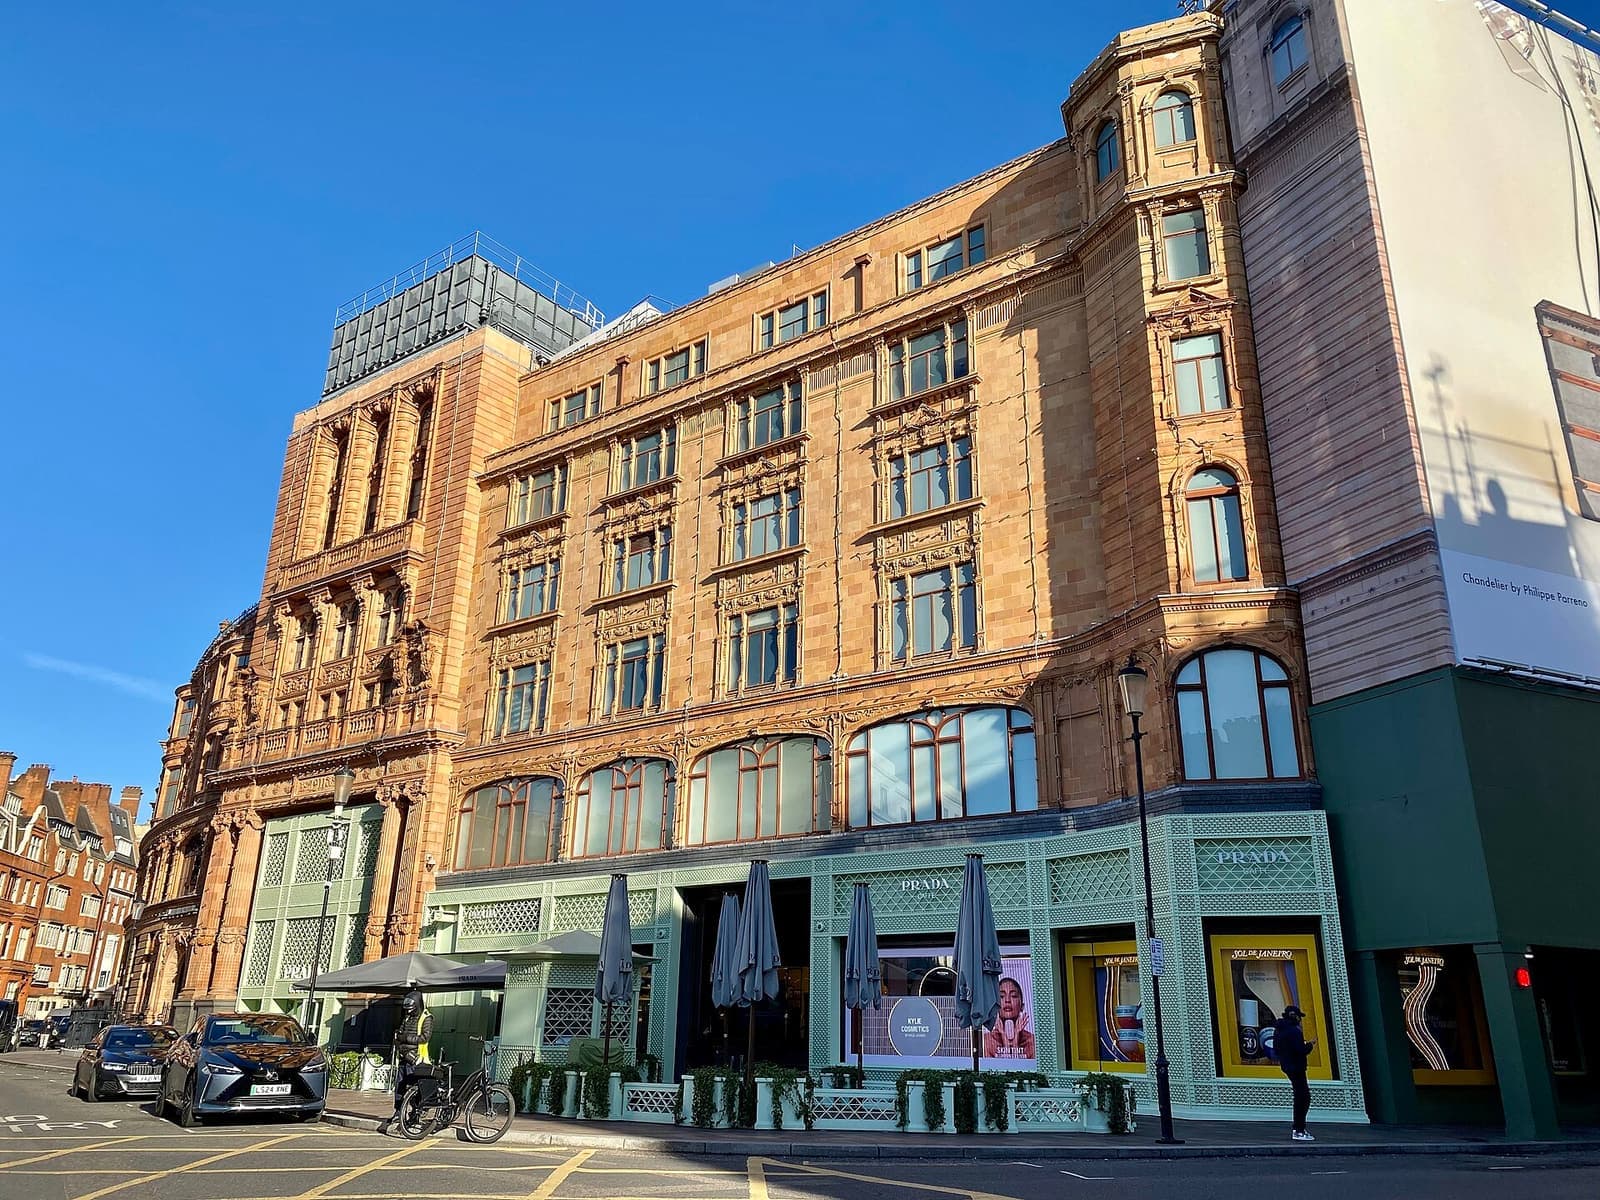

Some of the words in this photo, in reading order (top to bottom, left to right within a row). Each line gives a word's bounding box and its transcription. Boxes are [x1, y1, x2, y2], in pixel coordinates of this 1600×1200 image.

[1462, 572, 1508, 591] Chandelier
[1510, 581, 1521, 596] by
[1523, 584, 1556, 601] Philippe
[1556, 592, 1588, 607] Parreno
[1217, 850, 1291, 864] PRADA
[902, 878, 949, 890] PRADA
[1231, 950, 1248, 960] SOL
[1256, 950, 1293, 960] JANEIRO
